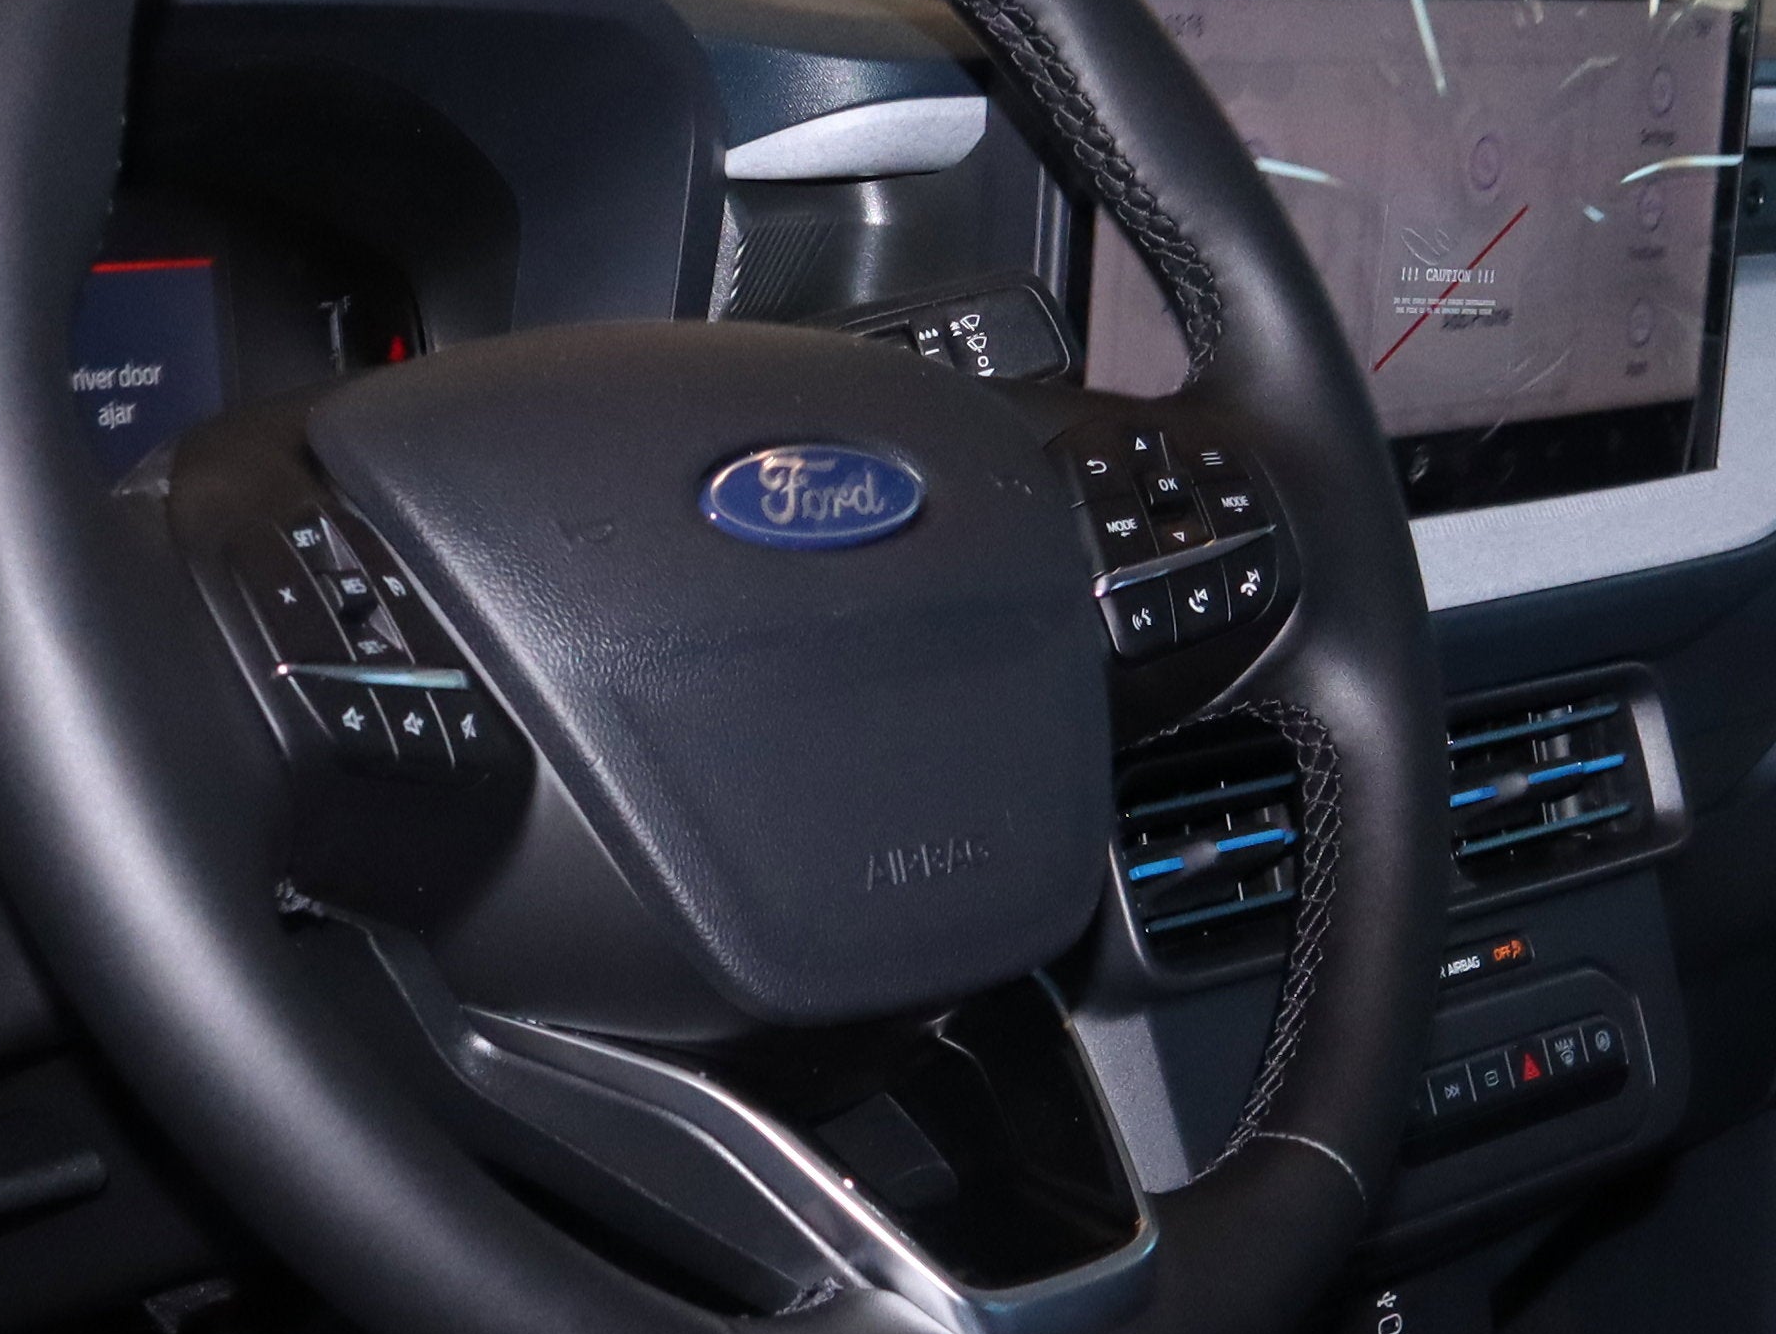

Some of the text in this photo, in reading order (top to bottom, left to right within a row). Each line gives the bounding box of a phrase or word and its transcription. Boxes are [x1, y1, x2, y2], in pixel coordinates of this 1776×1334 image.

[1425, 268, 1472, 283] CAUTION
[73, 362, 162, 391] river door
[99, 402, 136, 430] ajar
[757, 454, 886, 525] Ford
[1158, 478, 1179, 492] OK
[1221, 495, 1250, 508] MODE
[1106, 518, 1139, 534] MODE
[1447, 954, 1481, 977] AIRBAG
